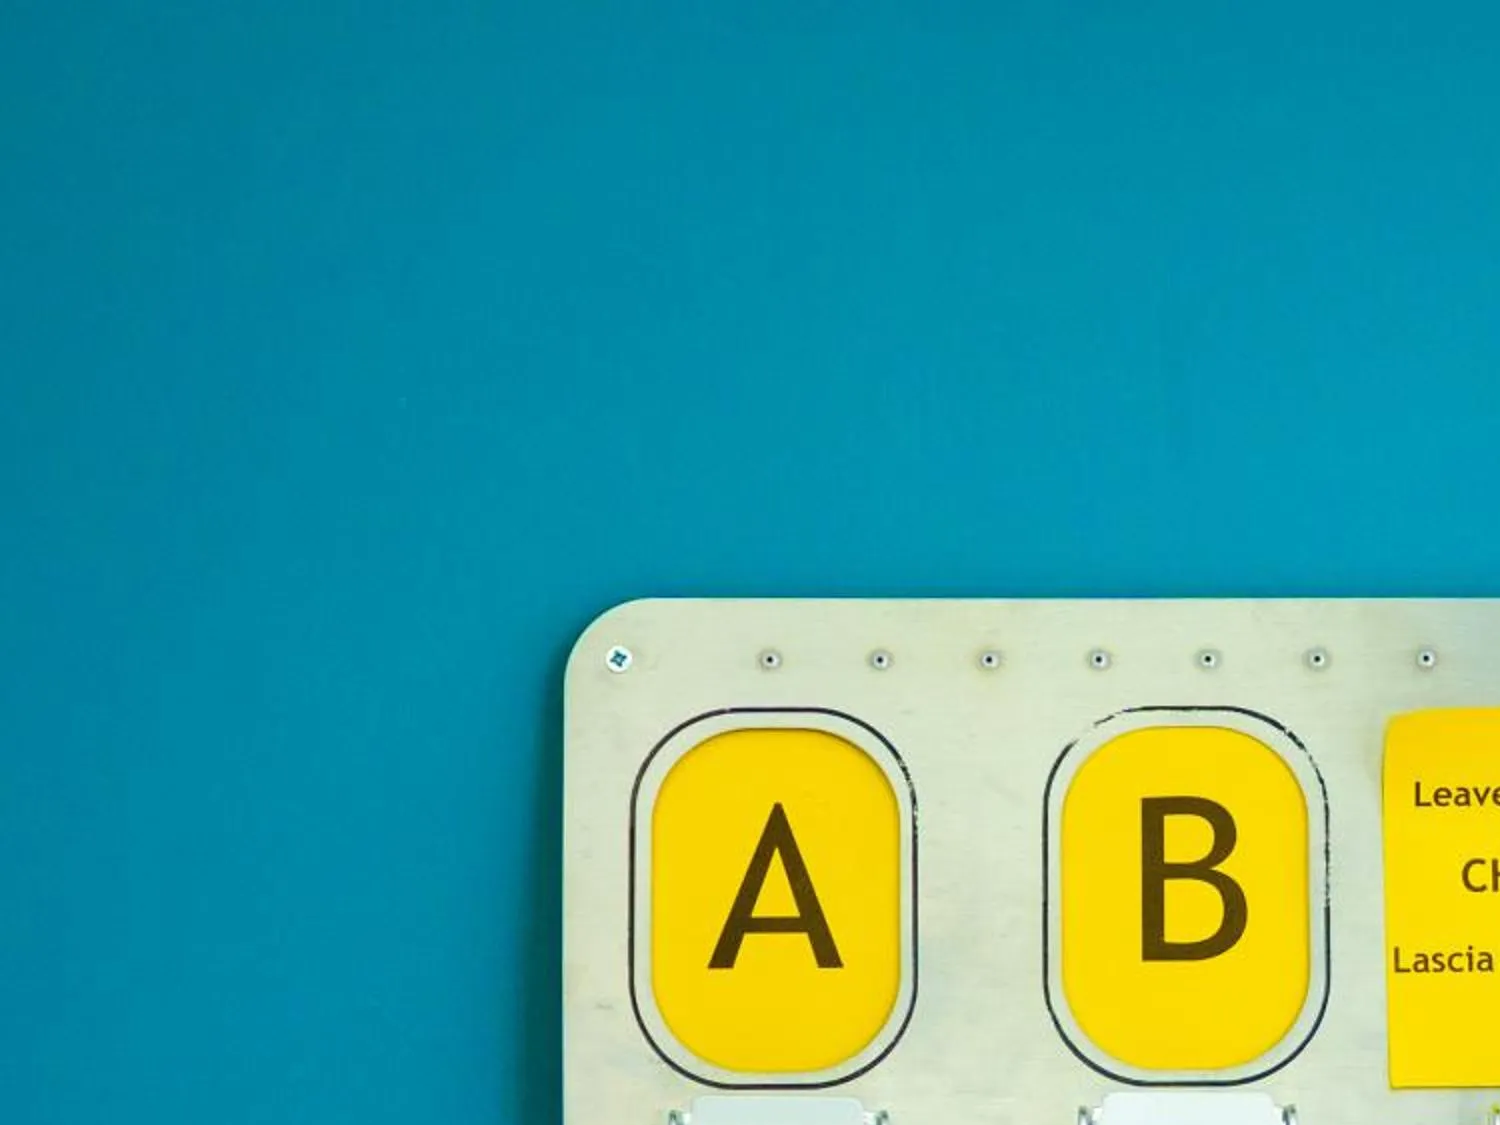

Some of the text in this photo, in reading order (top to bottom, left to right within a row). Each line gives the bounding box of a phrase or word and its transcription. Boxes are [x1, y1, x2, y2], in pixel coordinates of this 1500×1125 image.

[708, 803, 842, 968] A
[1141, 795, 1248, 962] B
[1393, 946, 1494, 973] Lascia
